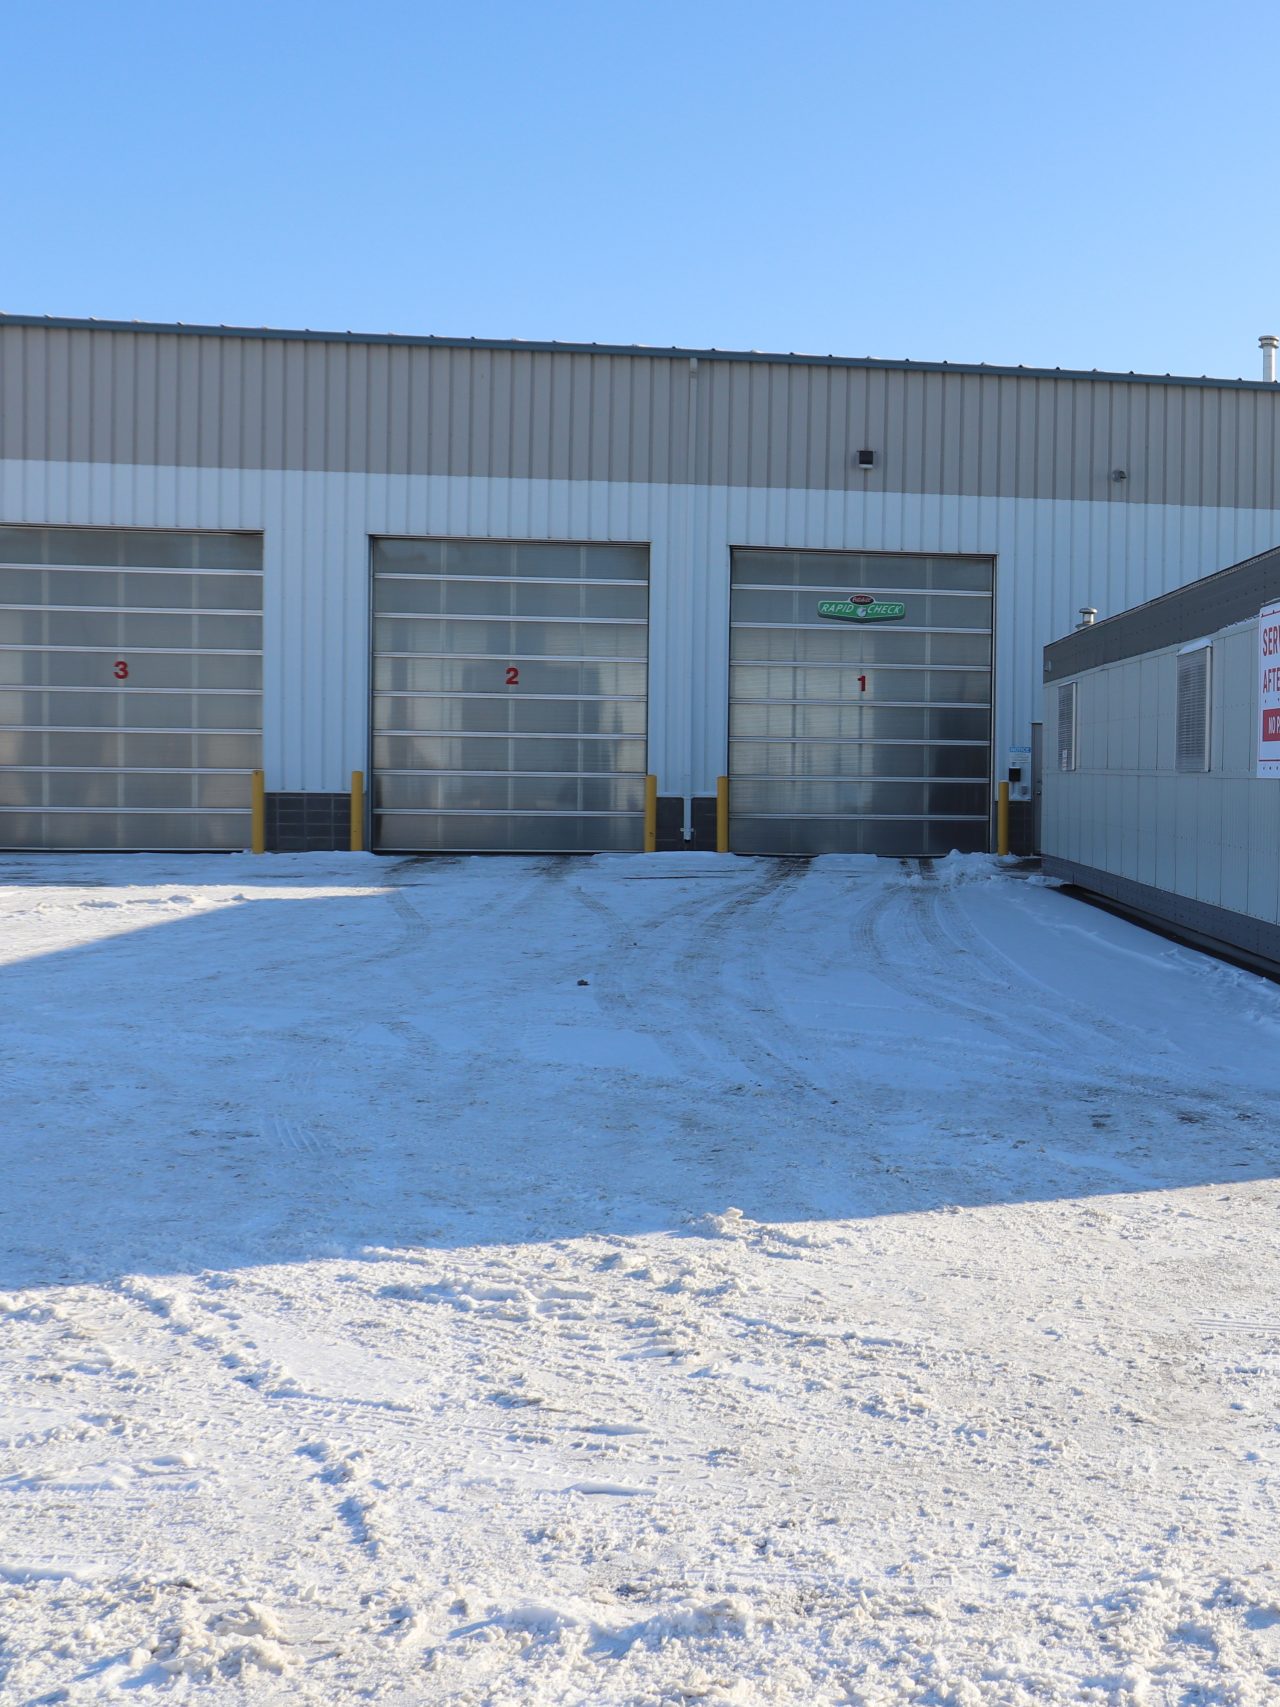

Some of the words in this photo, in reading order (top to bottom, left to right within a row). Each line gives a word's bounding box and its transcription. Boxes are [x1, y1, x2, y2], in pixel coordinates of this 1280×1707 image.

[821, 603, 854, 613] RAPID
[867, 604, 902, 614] CHECK
[113, 660, 129, 679] 3
[505, 667, 519, 685] 2
[857, 675, 866, 692] 1
[1268, 716, 1276, 735] NO
